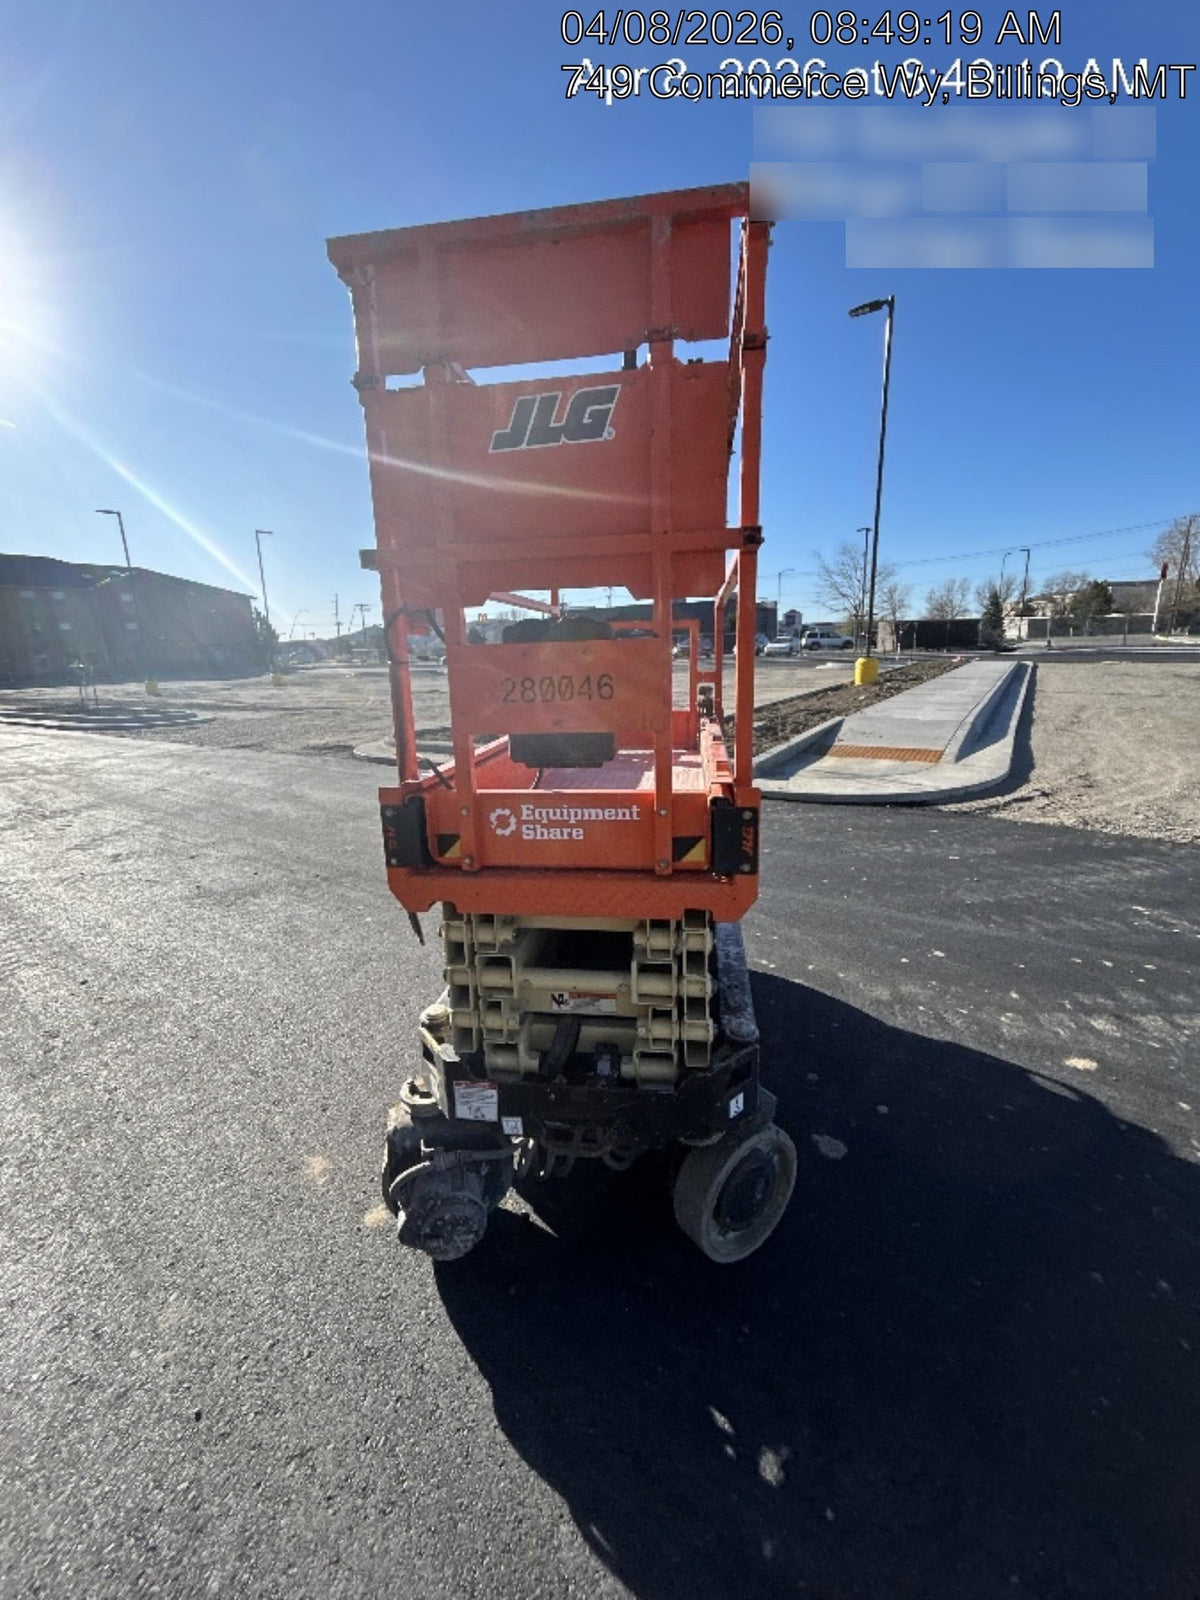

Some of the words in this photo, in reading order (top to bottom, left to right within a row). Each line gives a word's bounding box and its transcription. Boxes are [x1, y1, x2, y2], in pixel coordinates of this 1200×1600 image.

[489, 384, 621, 453] JLG
[501, 674, 615, 703] 280046
[520, 804, 641, 823] Equipment
[521, 824, 584, 840] Share
